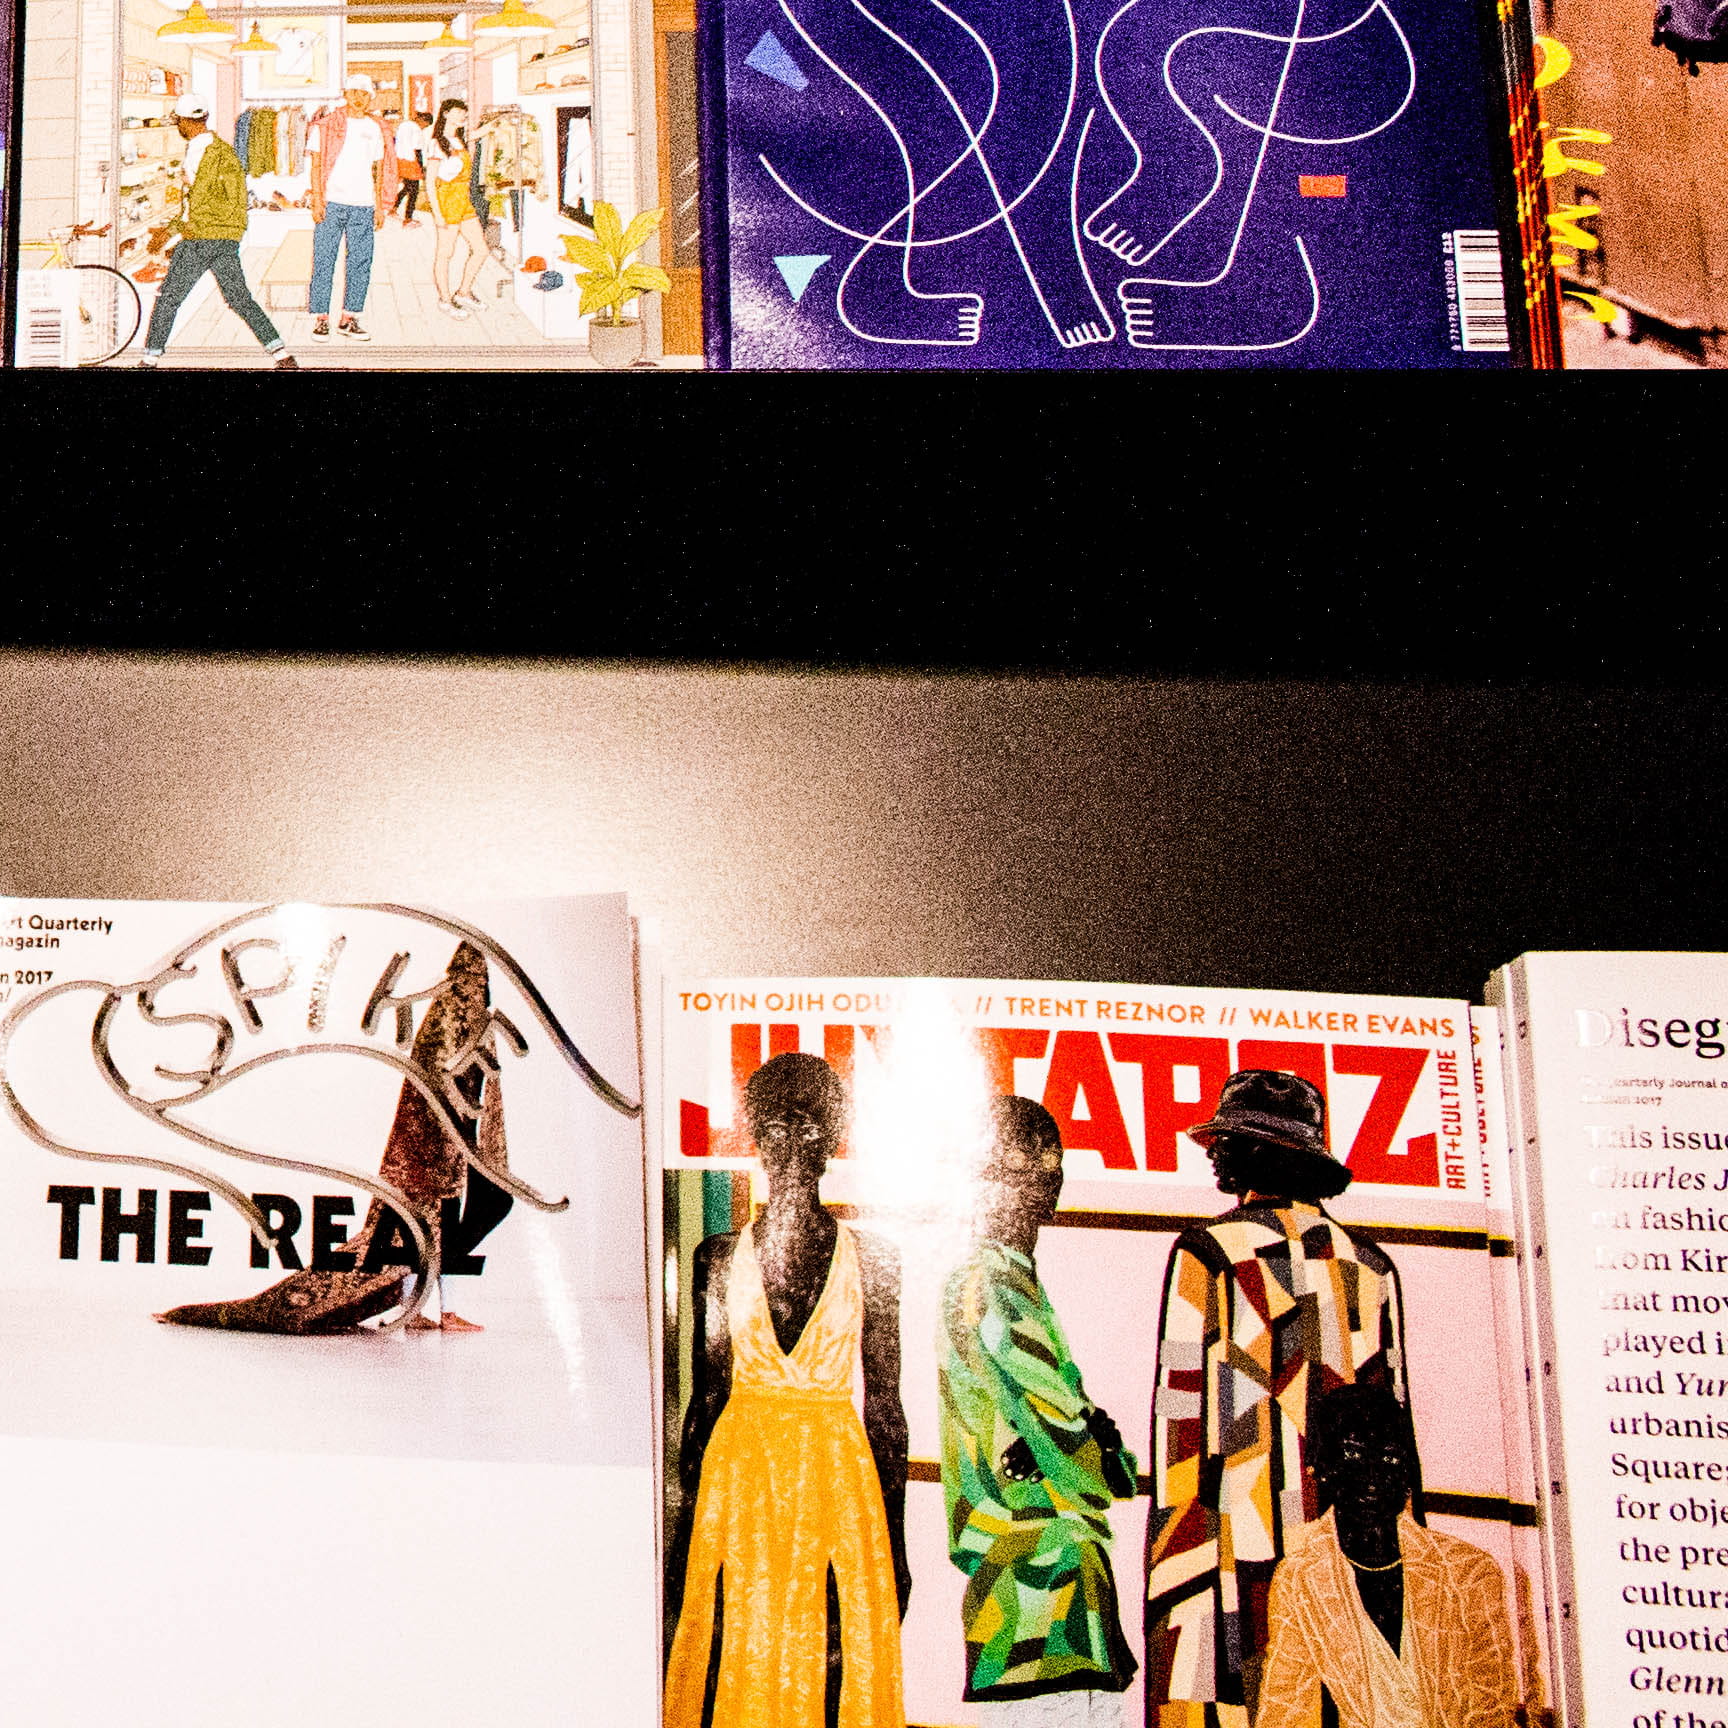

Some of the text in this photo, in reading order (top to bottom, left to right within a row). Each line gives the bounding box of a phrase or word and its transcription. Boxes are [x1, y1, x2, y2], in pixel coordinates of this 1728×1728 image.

[28, 914, 114, 936] Quarterly
[15, 970, 54, 985] 2017
[136, 935, 529, 1112] SPIKE
[678, 991, 759, 1017] TOYIN
[764, 992, 826, 1016] OJIH
[1004, 996, 1090, 1023] TRENT
[1096, 1000, 1206, 1026] REZNOR
[1247, 1007, 1359, 1034] WALKER
[1366, 1014, 1456, 1040] EVANS
[1668, 1077, 1718, 1090] Journal
[1441, 1047, 1463, 1190] ART+CULTURE
[1589, 1165, 1706, 1192] Charles
[47, 1184, 487, 1277] THE REAL
[1603, 1327, 1706, 1358] played
[1606, 1370, 1665, 1396] and
[1616, 1494, 1662, 1522] for
[1619, 1536, 1671, 1564] the
[1630, 1666, 1725, 1697] Glenn
